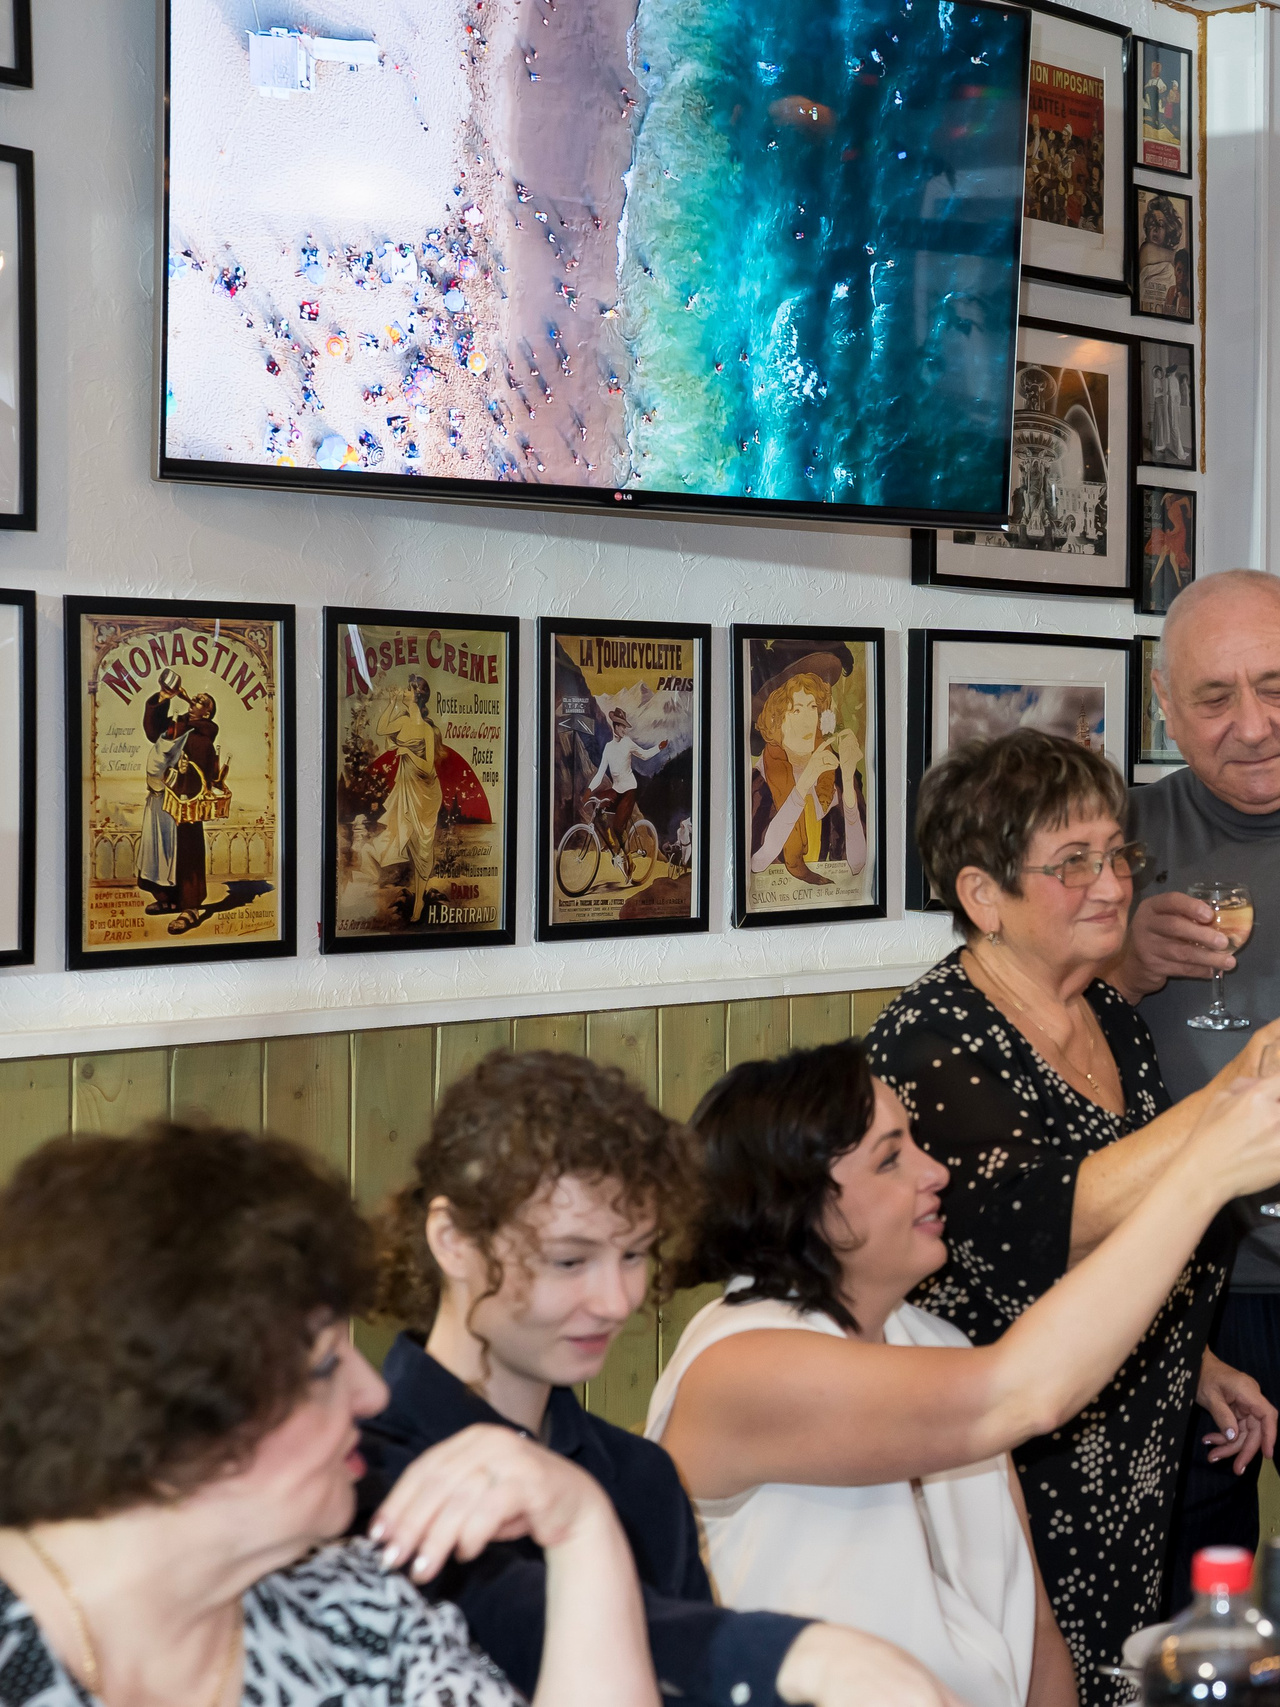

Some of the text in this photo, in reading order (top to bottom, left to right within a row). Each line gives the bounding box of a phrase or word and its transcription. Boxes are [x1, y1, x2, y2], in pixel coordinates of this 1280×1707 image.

[1052, 69, 1104, 100] IMPOSANTE
[622, 493, 633, 501] LG
[344, 630, 420, 698] ROSÉE
[579, 638, 682, 674] LA TOURICYCLETTE
[101, 633, 268, 711] MONASTINE
[656, 677, 694, 692] PARIS
[436, 691, 500, 716] ROSÉE DE LA BOUCHE
[106, 722, 135, 738] Liqueur
[444, 721, 471, 739] Rosée
[477, 722, 501, 743] Corps
[482, 768, 499, 786] neige
[114, 891, 141, 900] CENTRAL
[451, 883, 480, 899] PARIS
[751, 888, 814, 904] SALON DES CENT
[95, 900, 144, 909] ADMINISTRATION
[245, 907, 275, 922] Signature
[428, 904, 497, 924] H. BERTRAND
[107, 917, 145, 929] CAPUCINES
[103, 930, 133, 941] PARIS
